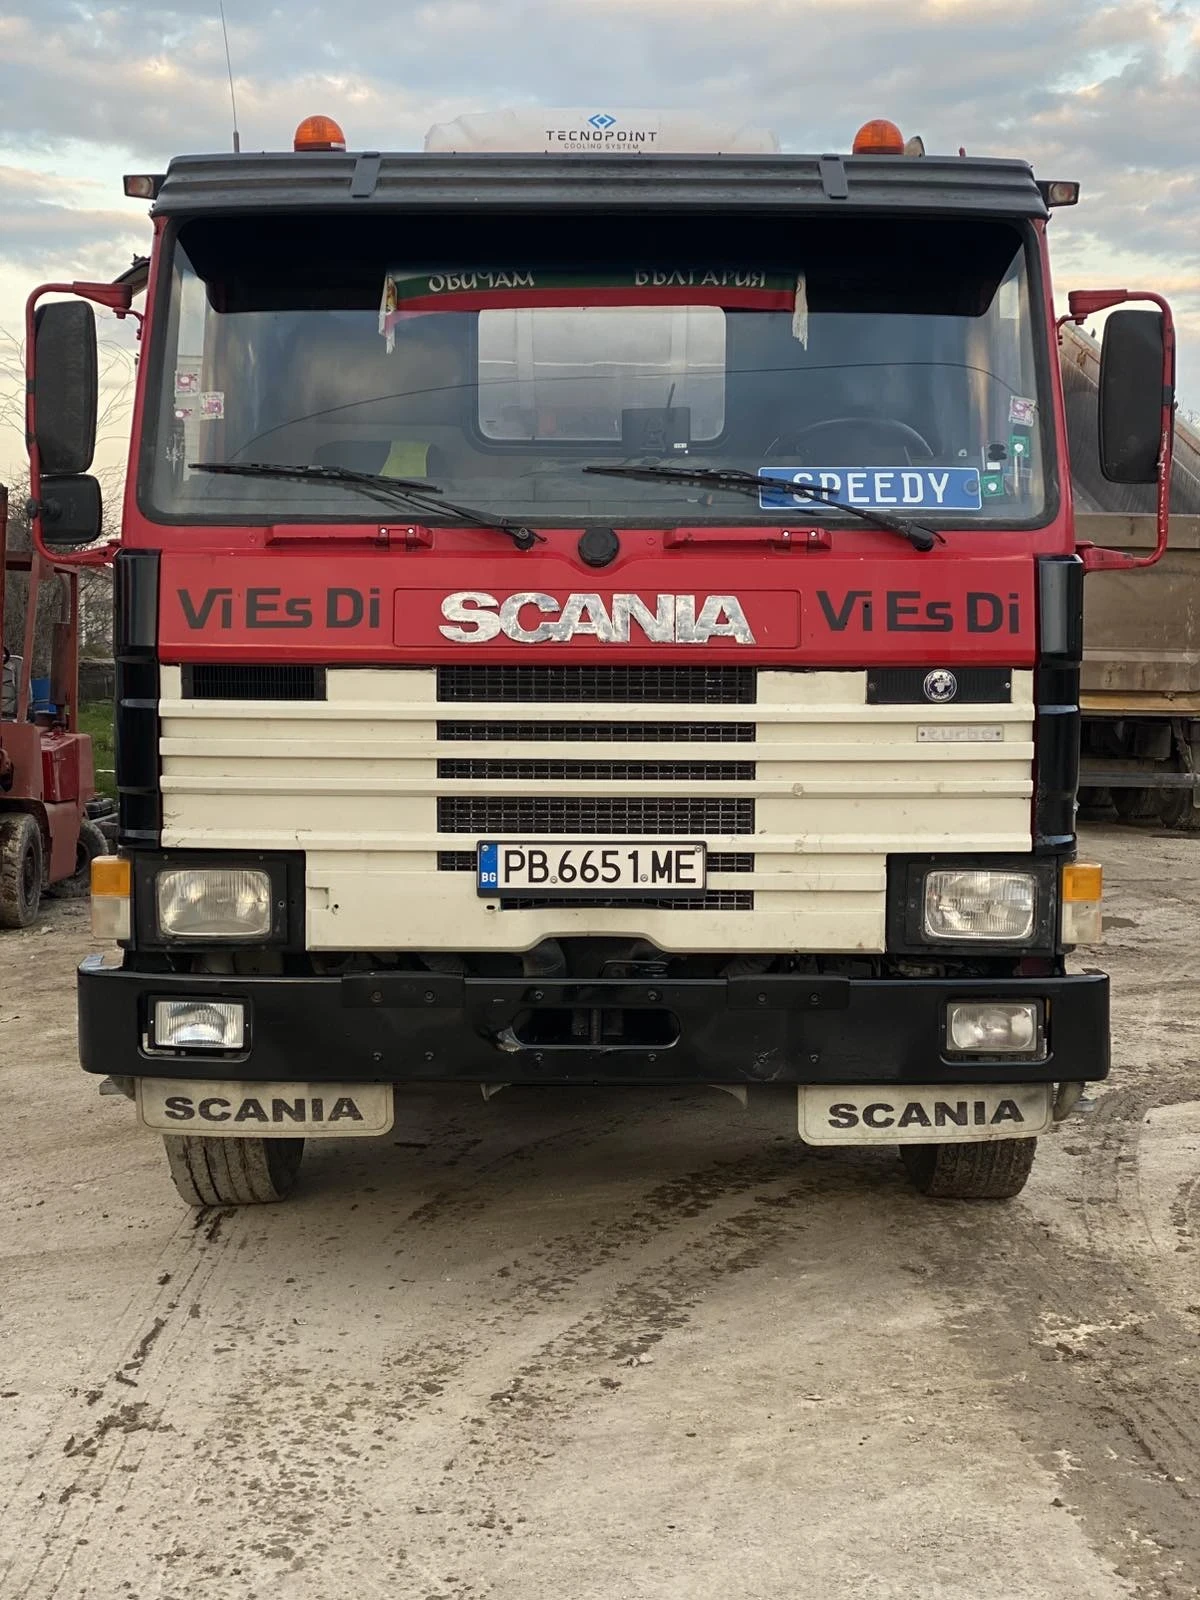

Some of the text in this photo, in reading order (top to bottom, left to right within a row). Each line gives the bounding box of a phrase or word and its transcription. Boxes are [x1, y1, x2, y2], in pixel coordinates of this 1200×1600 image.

[546, 130, 657, 142] TECNOPOINT
[428, 270, 535, 292] ОБИЧАМ
[792, 472, 950, 504] SPEEDY
[438, 591, 756, 644] SCANIA
[481, 872, 497, 883] BG
[164, 1096, 364, 1122] SCANIA
[827, 1099, 1025, 1129] SCANIA
